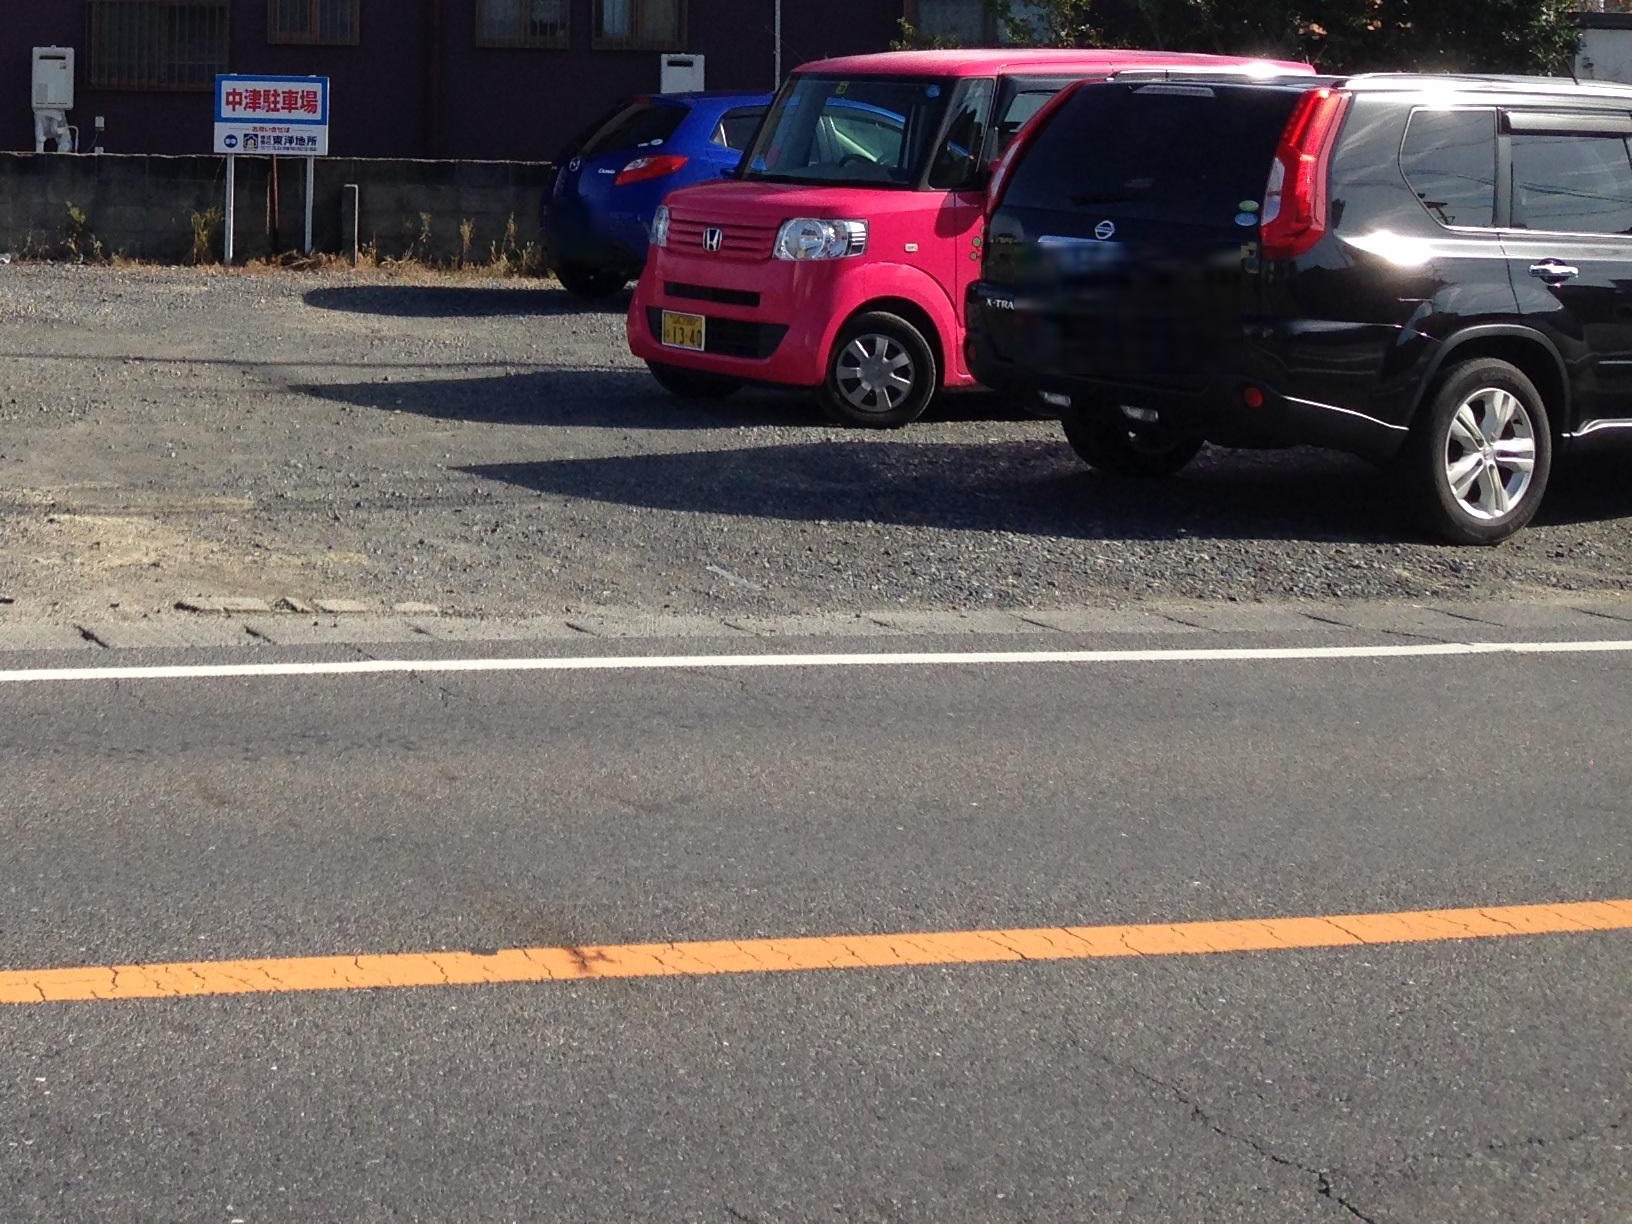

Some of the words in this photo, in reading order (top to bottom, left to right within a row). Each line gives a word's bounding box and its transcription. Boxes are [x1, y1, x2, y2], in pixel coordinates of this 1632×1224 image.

[225, 88, 318, 114] 中津駐車場
[986, 298, 1016, 310] X-TRA
